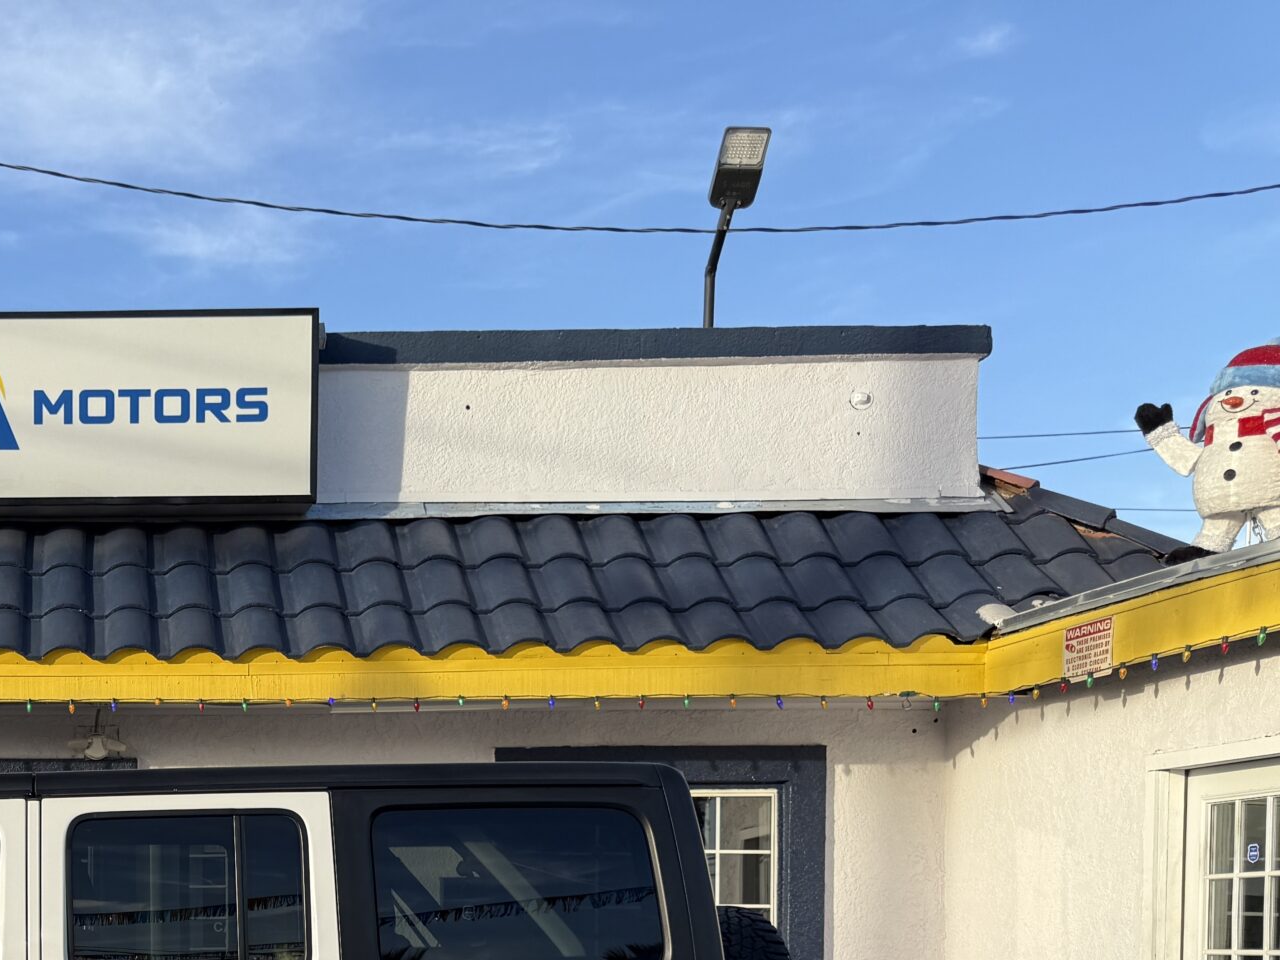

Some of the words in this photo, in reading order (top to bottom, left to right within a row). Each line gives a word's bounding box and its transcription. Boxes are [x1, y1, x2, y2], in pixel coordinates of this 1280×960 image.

[33, 386, 269, 425] MOTORS
[1066, 620, 1111, 640] WARNING
[1090, 632, 1111, 644] PREMISES
[1076, 646, 1084, 654] ARE
[1085, 643, 1104, 652] SECURED
[1066, 653, 1092, 665] ELECTRONIC
[1093, 648, 1109, 658] ALARM
[1089, 657, 1108, 667] CIRCUIT
